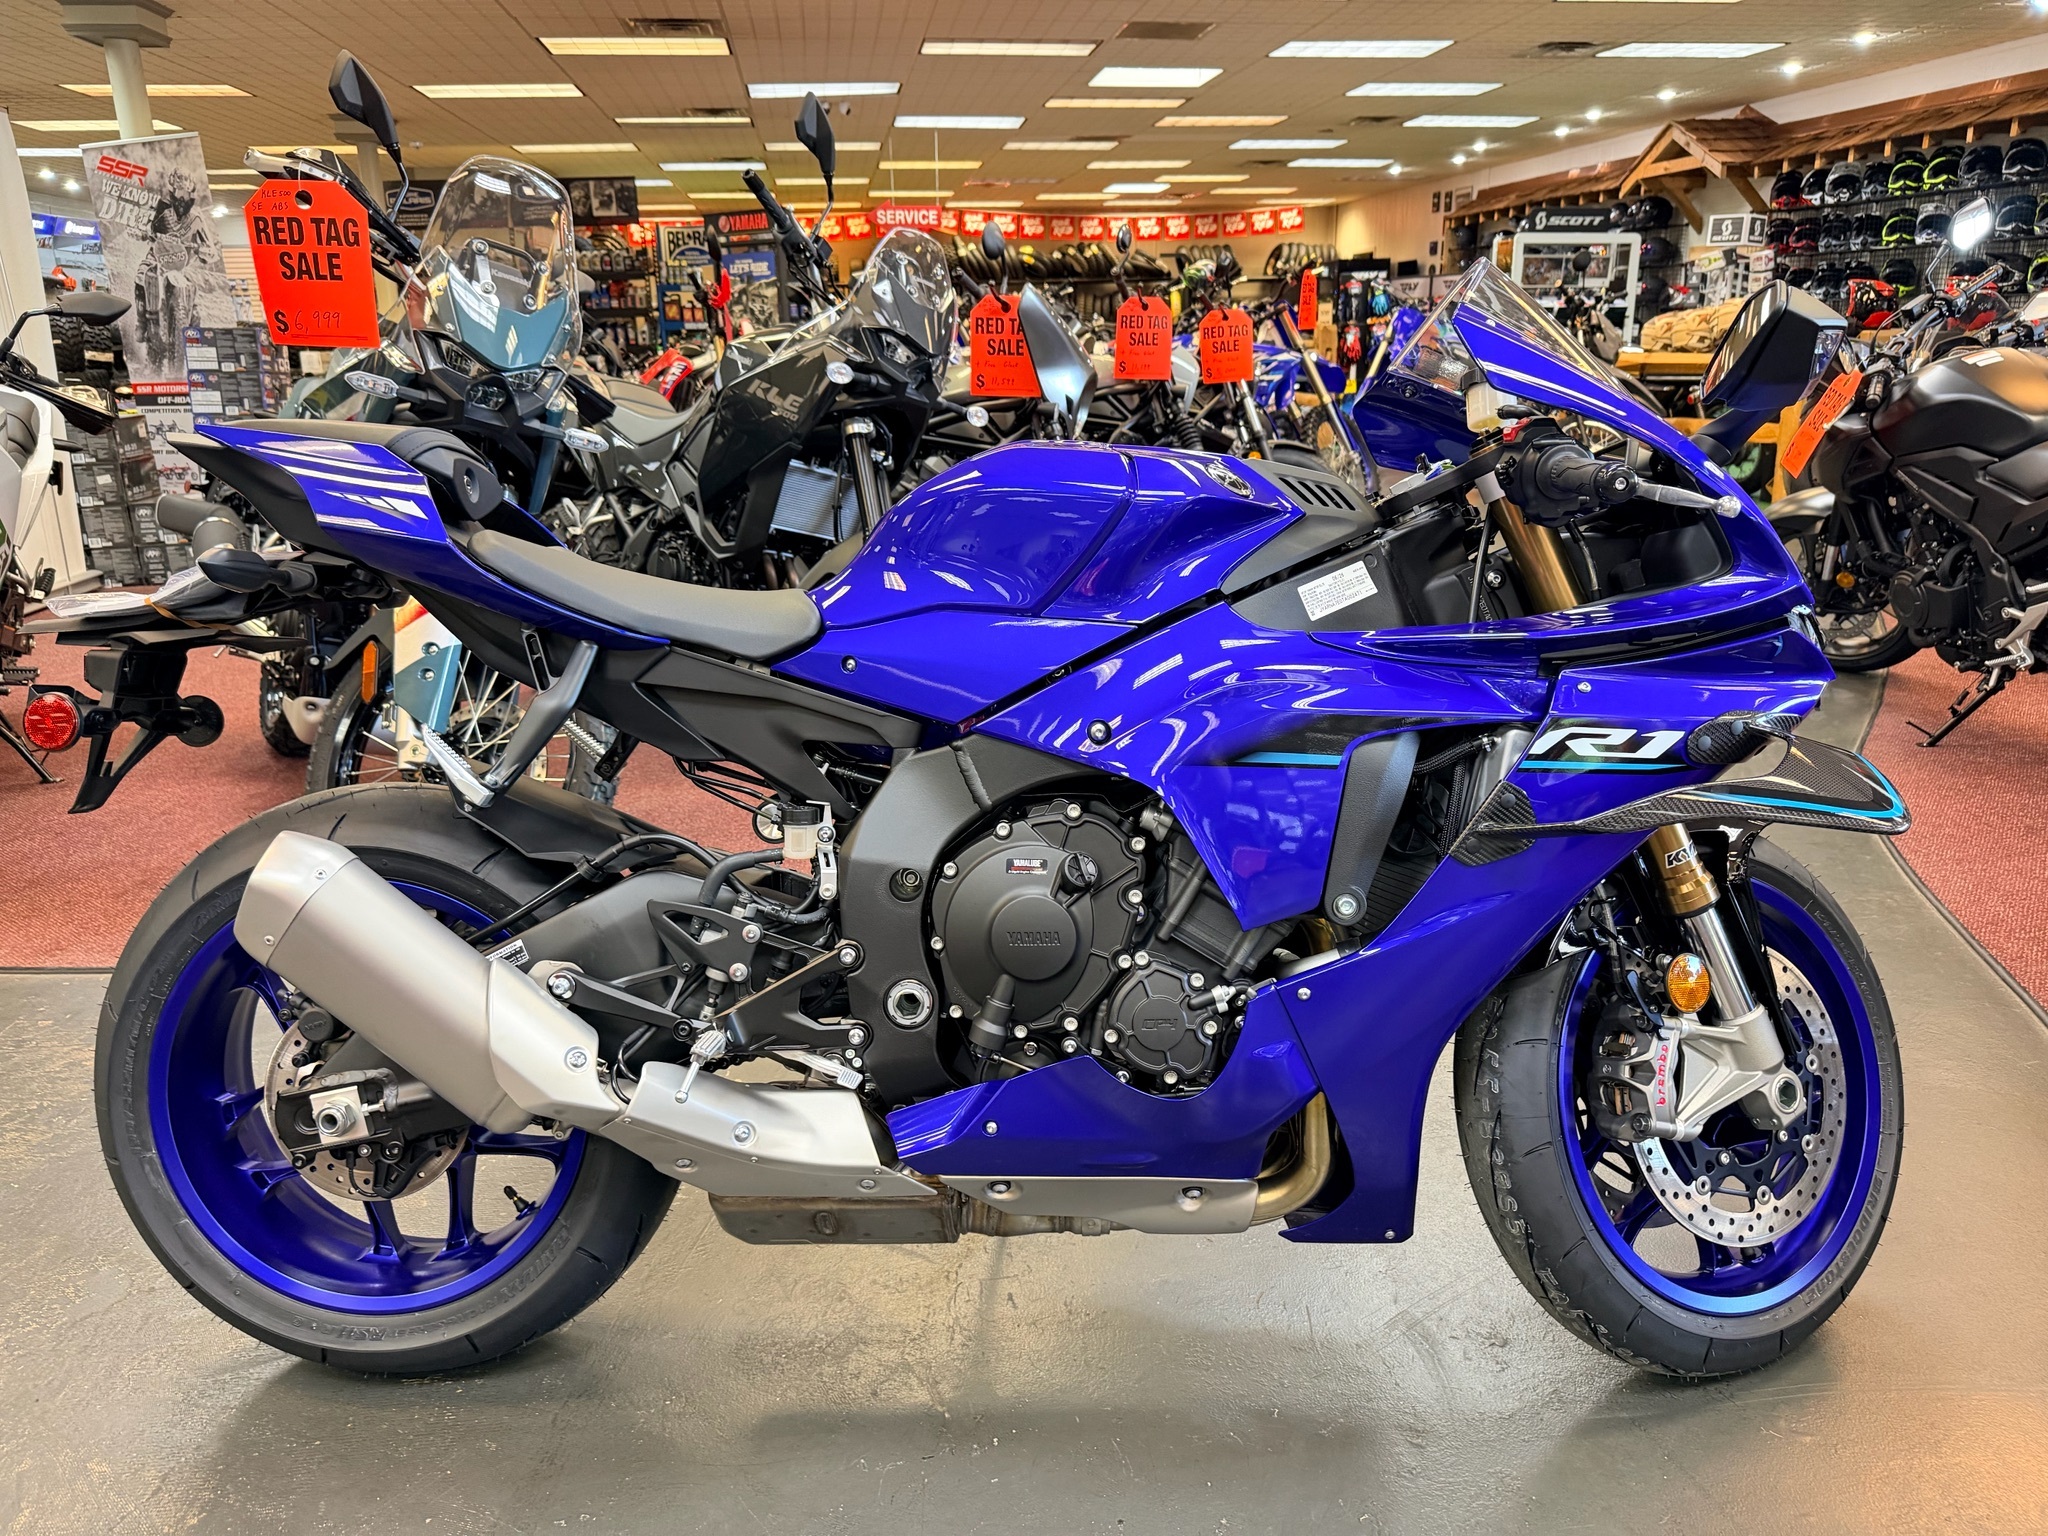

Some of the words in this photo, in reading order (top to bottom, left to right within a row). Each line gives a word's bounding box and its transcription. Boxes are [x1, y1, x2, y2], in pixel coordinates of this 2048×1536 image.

[96, 155, 149, 187] SSR
[101, 179, 121, 196] WE
[121, 185, 162, 208] KNOW
[251, 201, 263, 211] SE
[271, 201, 289, 211] ABS
[729, 211, 769, 232] YAMAHA
[877, 207, 939, 226] SERVICE
[1547, 215, 1605, 226] SCOTT
[253, 215, 305, 246] RED
[309, 216, 361, 248] TAG
[278, 250, 344, 281] SALE
[273, 310, 290, 335] $
[295, 310, 341, 334] 6,999
[975, 316, 1005, 335] RED
[1008, 317, 1023, 336] TA
[1120, 315, 1144, 329] RED
[1147, 315, 1168, 329] TAG
[1128, 331, 1159, 347] SALE
[1203, 326, 1225, 340] RED
[1228, 324, 1249, 338] TAG
[986, 338, 1025, 356] SALE
[1212, 339, 1240, 354] SALE
[1118, 360, 1127, 374] $
[975, 373, 986, 389] $
[747, 378, 805, 413] KLE
[1528, 726, 1686, 759] R1
[1007, 931, 1061, 947] YAMAHA
[1656, 1043, 1670, 1107] brembo
